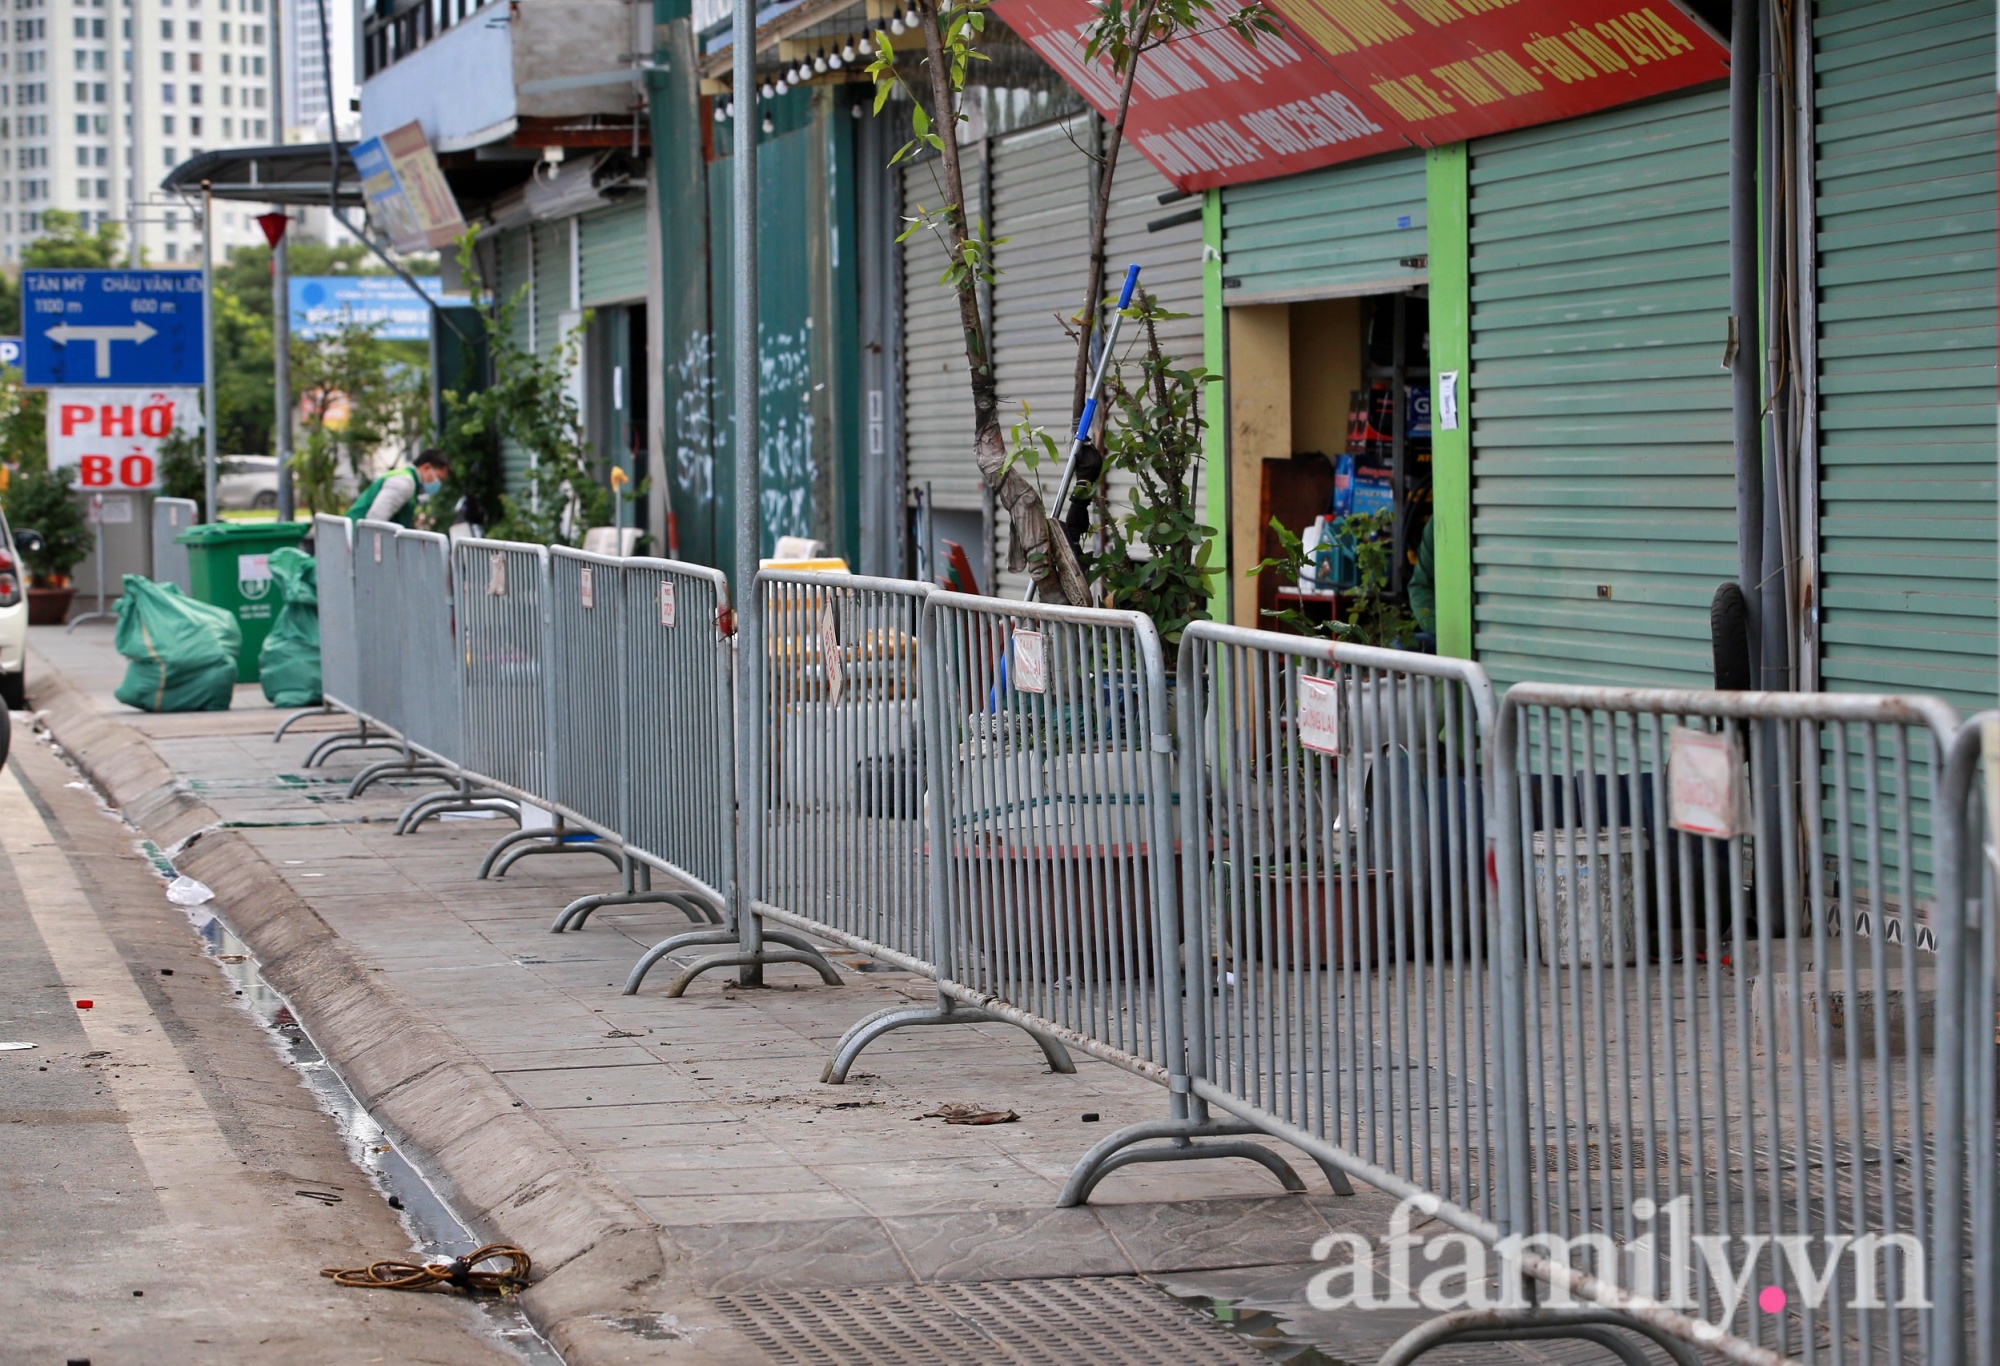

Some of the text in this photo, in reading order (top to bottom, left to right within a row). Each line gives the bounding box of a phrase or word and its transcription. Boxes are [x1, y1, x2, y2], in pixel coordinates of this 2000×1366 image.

[1522, 32, 1597, 84] CỨU
[1562, 21, 1638, 78] HỘ
[1595, 7, 1695, 66] 24/24
[1430, 60, 1506, 107] THAY
[1467, 40, 1544, 96] DẦU
[1369, 73, 1436, 122] RỬA
[1400, 74, 1457, 115] XE
[1186, 120, 1264, 168] 24/24
[66, 301, 83, 313] m
[160, 301, 176, 313] m
[60, 392, 176, 438] PHỞ
[80, 445, 154, 488] BÒ
